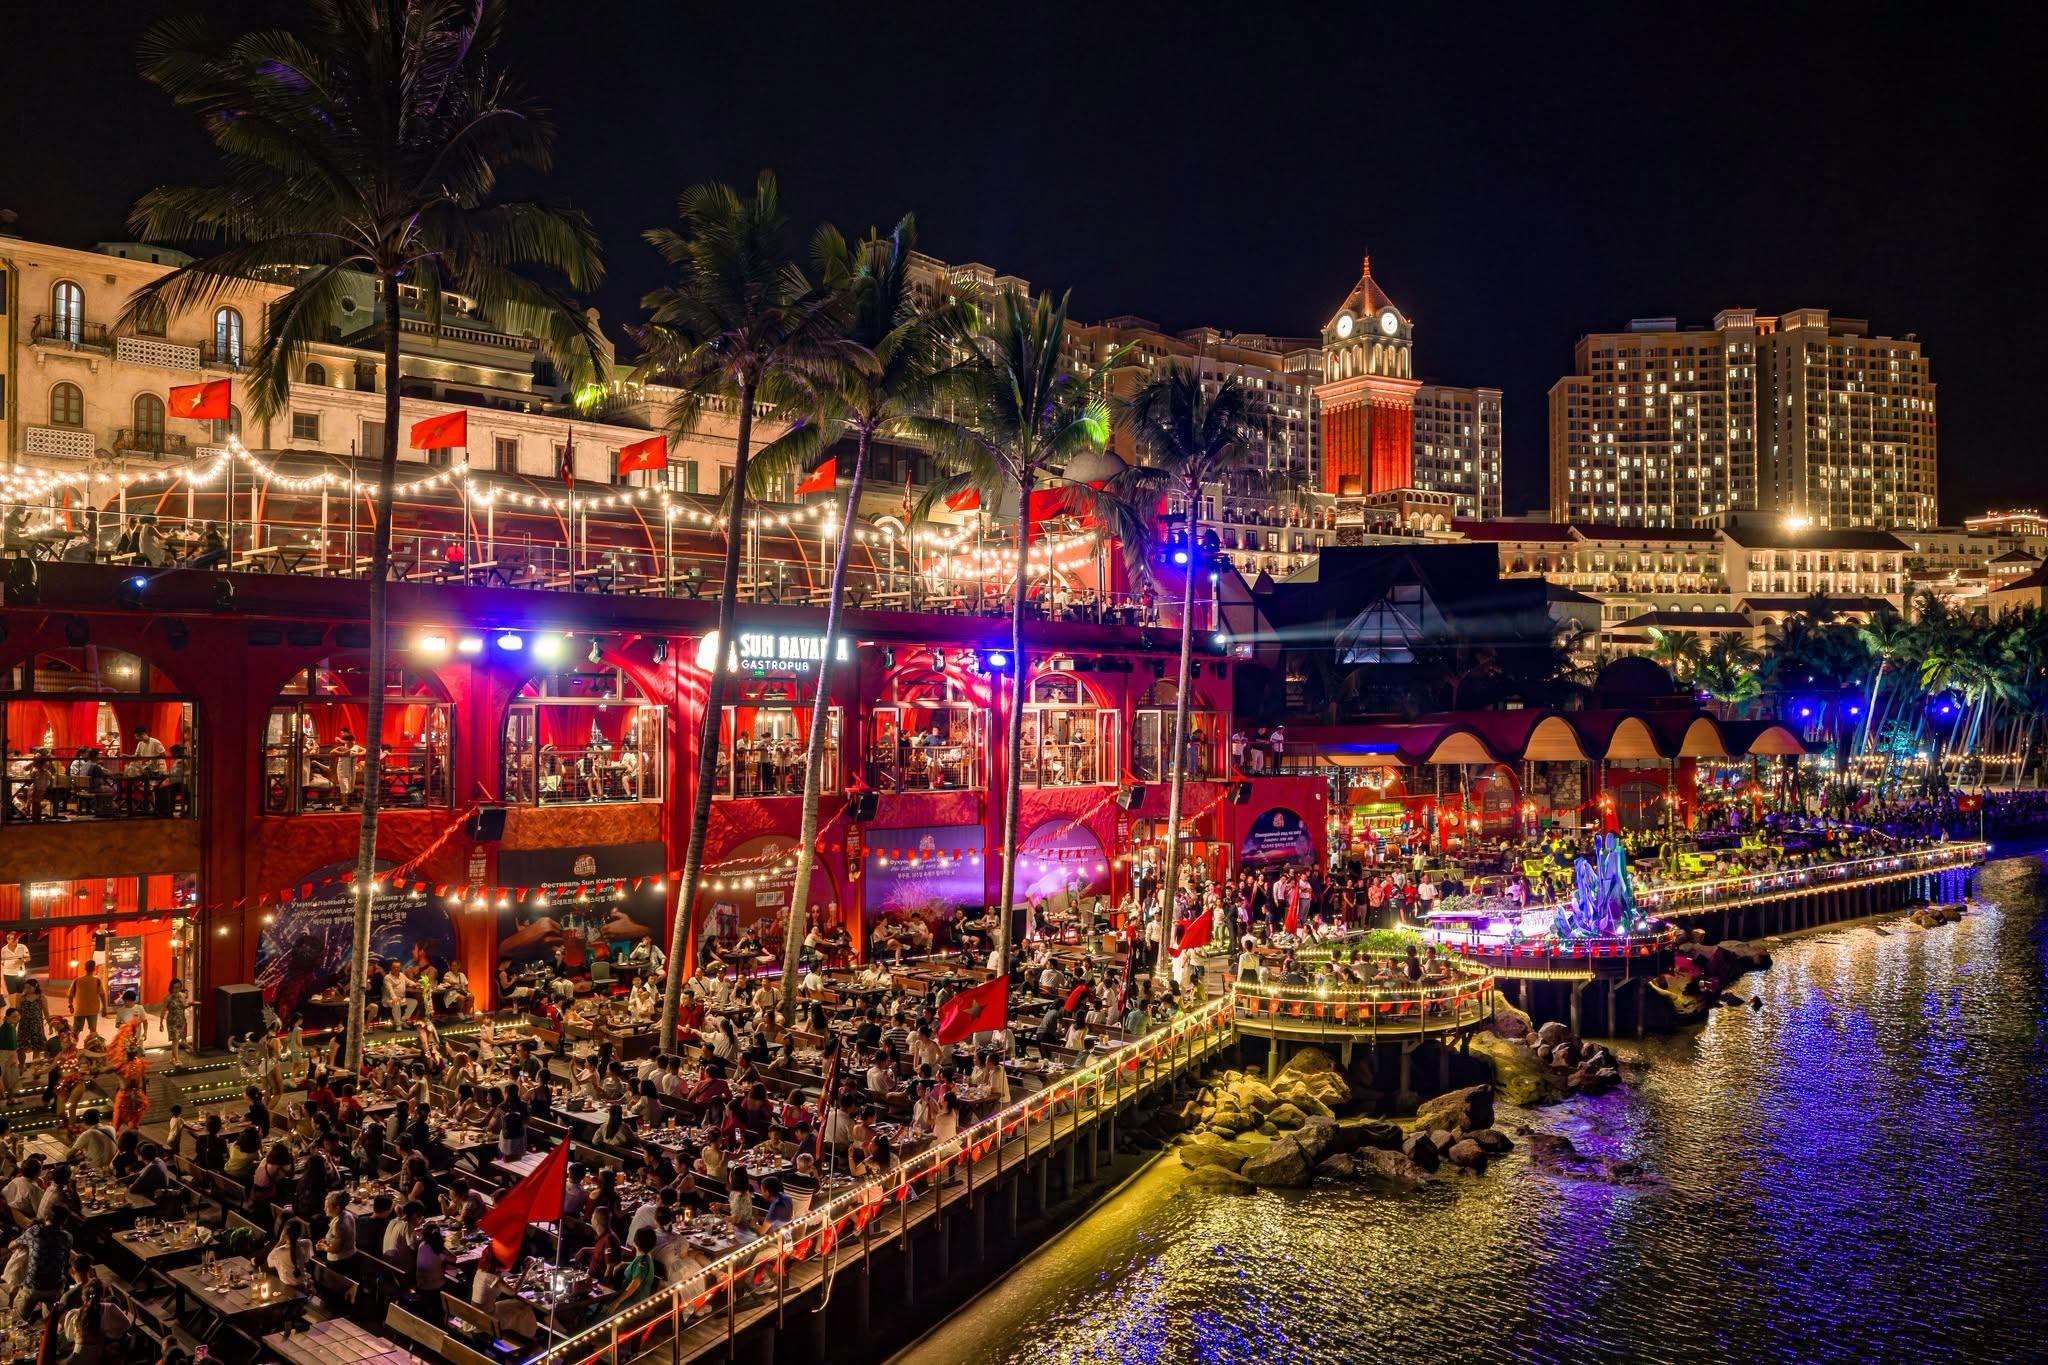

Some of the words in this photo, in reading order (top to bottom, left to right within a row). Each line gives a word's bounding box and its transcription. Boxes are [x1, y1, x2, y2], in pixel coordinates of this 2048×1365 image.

[740, 633, 774, 657] SUN
[779, 636, 848, 660] BAVARA
[741, 660, 809, 671] GASTROPUB
[291, 898, 346, 908] Уникльный
